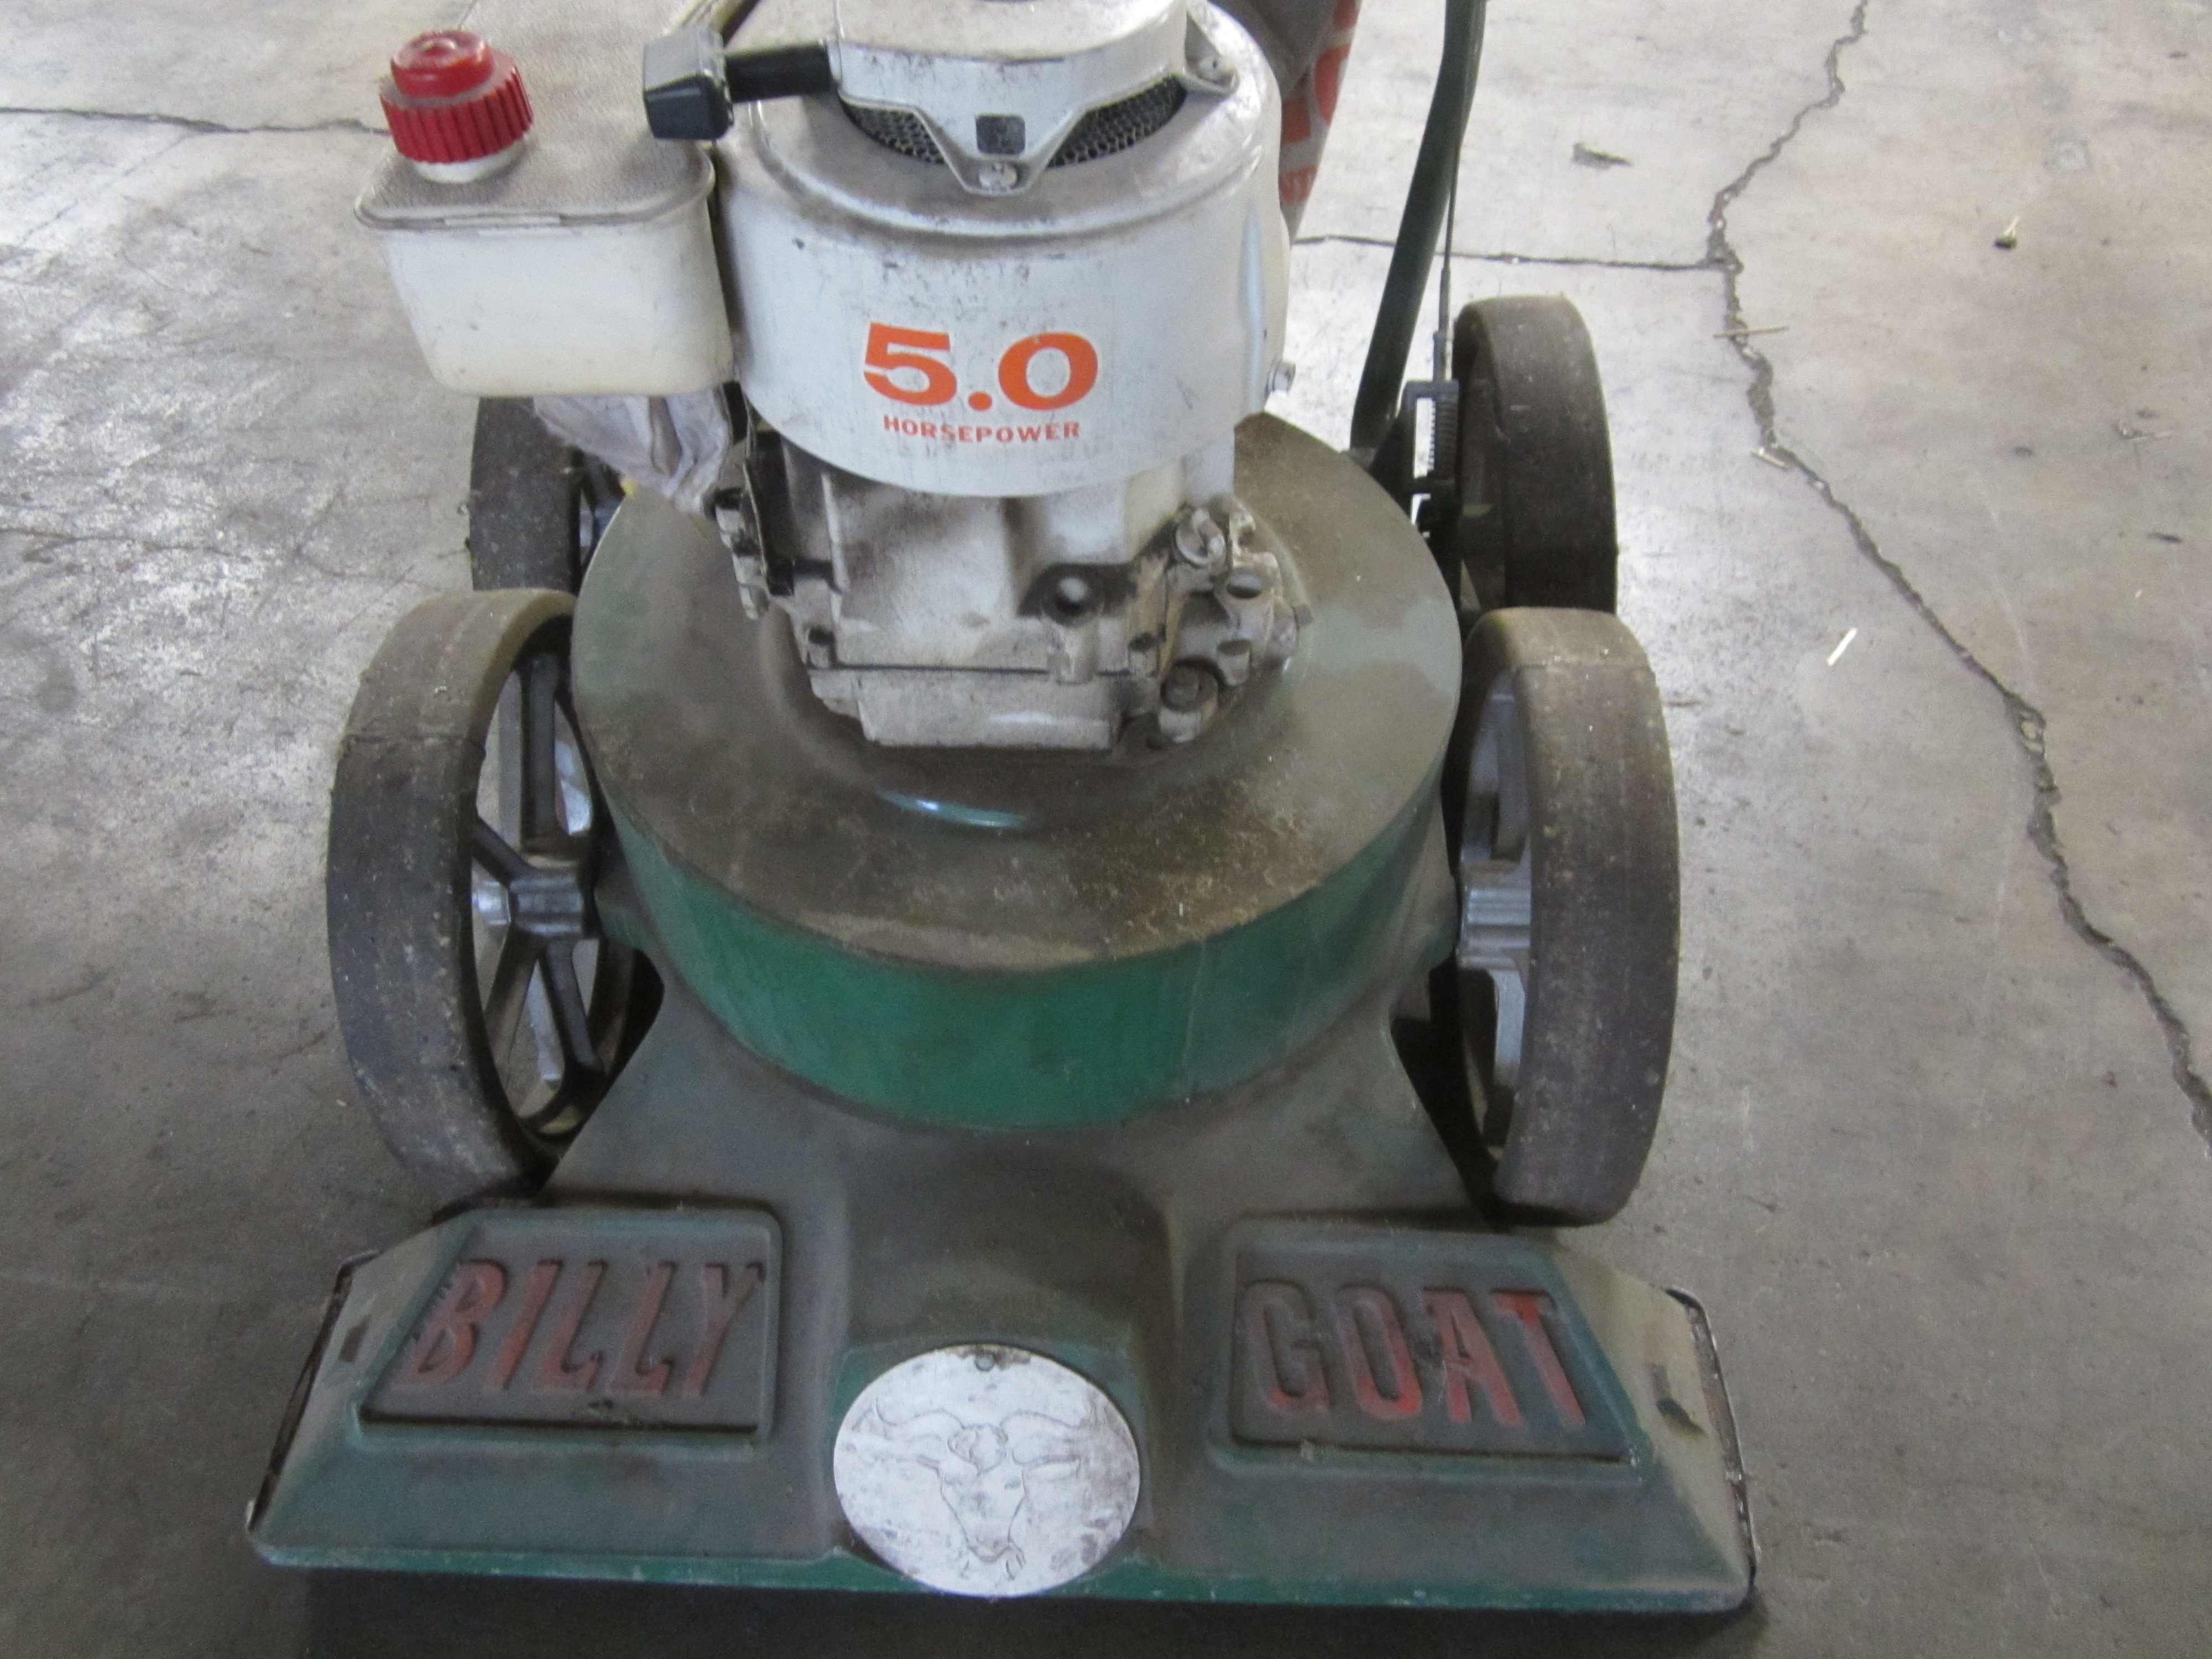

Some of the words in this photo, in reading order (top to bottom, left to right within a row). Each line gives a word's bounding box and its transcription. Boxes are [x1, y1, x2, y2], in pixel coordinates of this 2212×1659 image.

[863, 322, 1099, 411] 5.0
[884, 415, 1080, 443] HORSEPOWER
[385, 1258, 765, 1398] BILLY
[1235, 1279, 1586, 1428] GOAT
